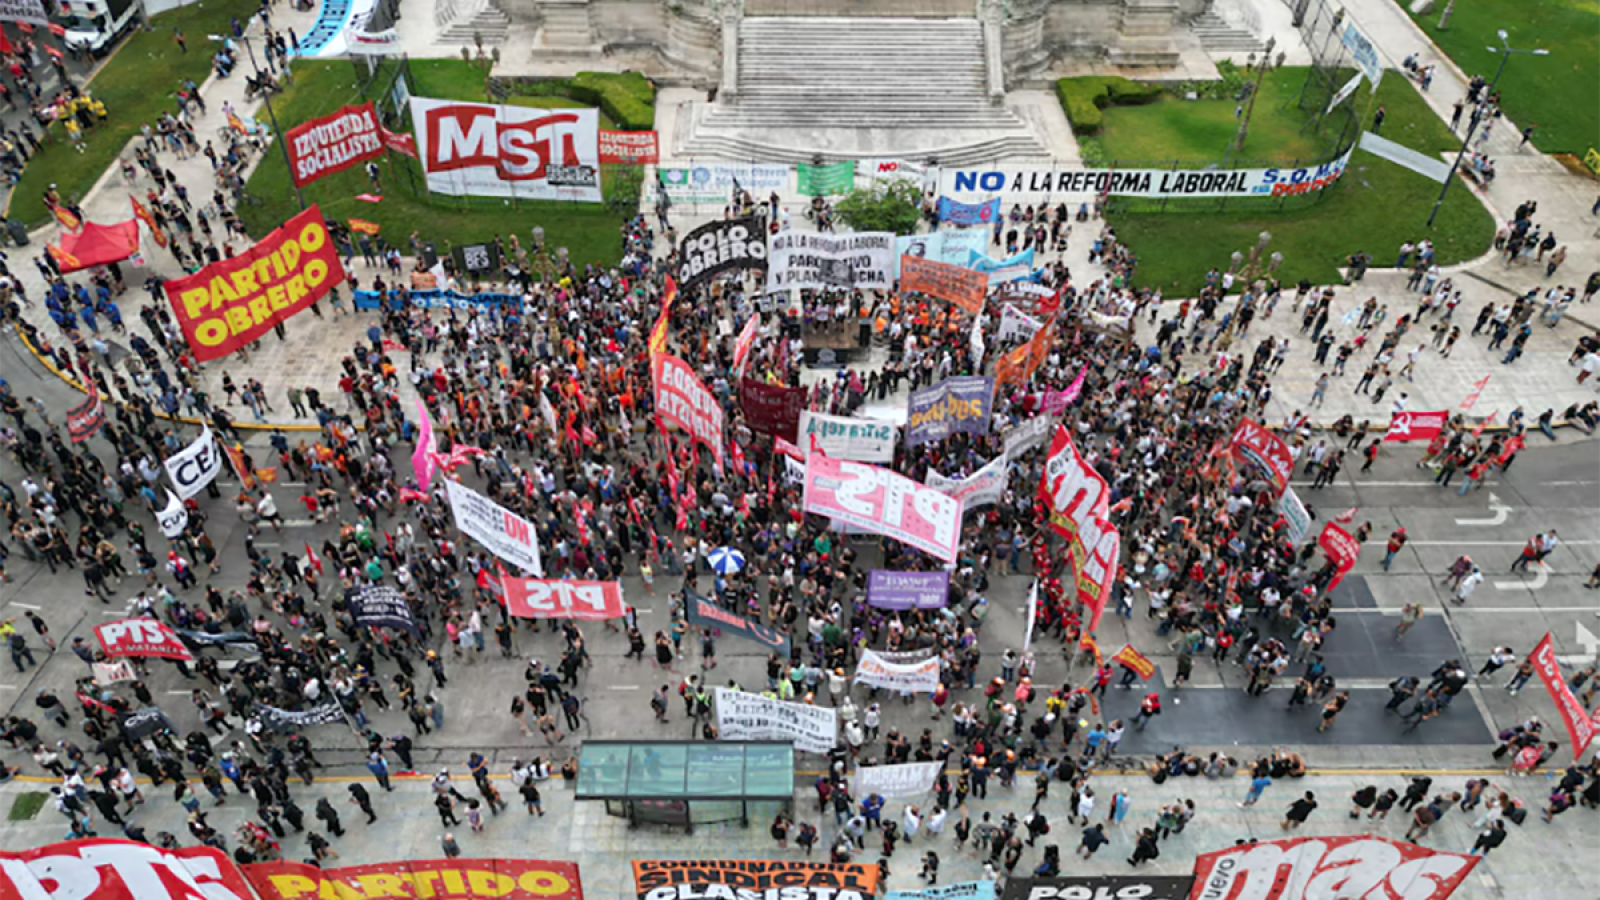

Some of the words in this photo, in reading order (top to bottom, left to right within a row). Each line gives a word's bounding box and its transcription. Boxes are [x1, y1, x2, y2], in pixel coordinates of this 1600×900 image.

[294, 111, 375, 157] IZQUIERDA
[437, 113, 580, 175] MST
[297, 131, 381, 179] SOCIALISTA
[955, 171, 1006, 192] NO
[1011, 171, 1022, 192] A
[1029, 171, 1051, 192] LA
[1057, 172, 1150, 192] REFORMA
[1159, 172, 1248, 193] LABORAL
[685, 225, 749, 260] POLO
[849, 236, 889, 249] LABORAL
[180, 222, 325, 319] PARTIDO
[680, 240, 765, 284] OBRERO
[195, 259, 328, 346] OBRERO
[100, 619, 165, 645] PTS
[0, 843, 244, 900] PTS
[268, 868, 570, 900] PARTIDO
[639, 860, 865, 875] COORDINADORA
[639, 869, 868, 891] SINDICAL
[644, 883, 863, 900] CLASISTA
[1028, 884, 1154, 900] POLO
